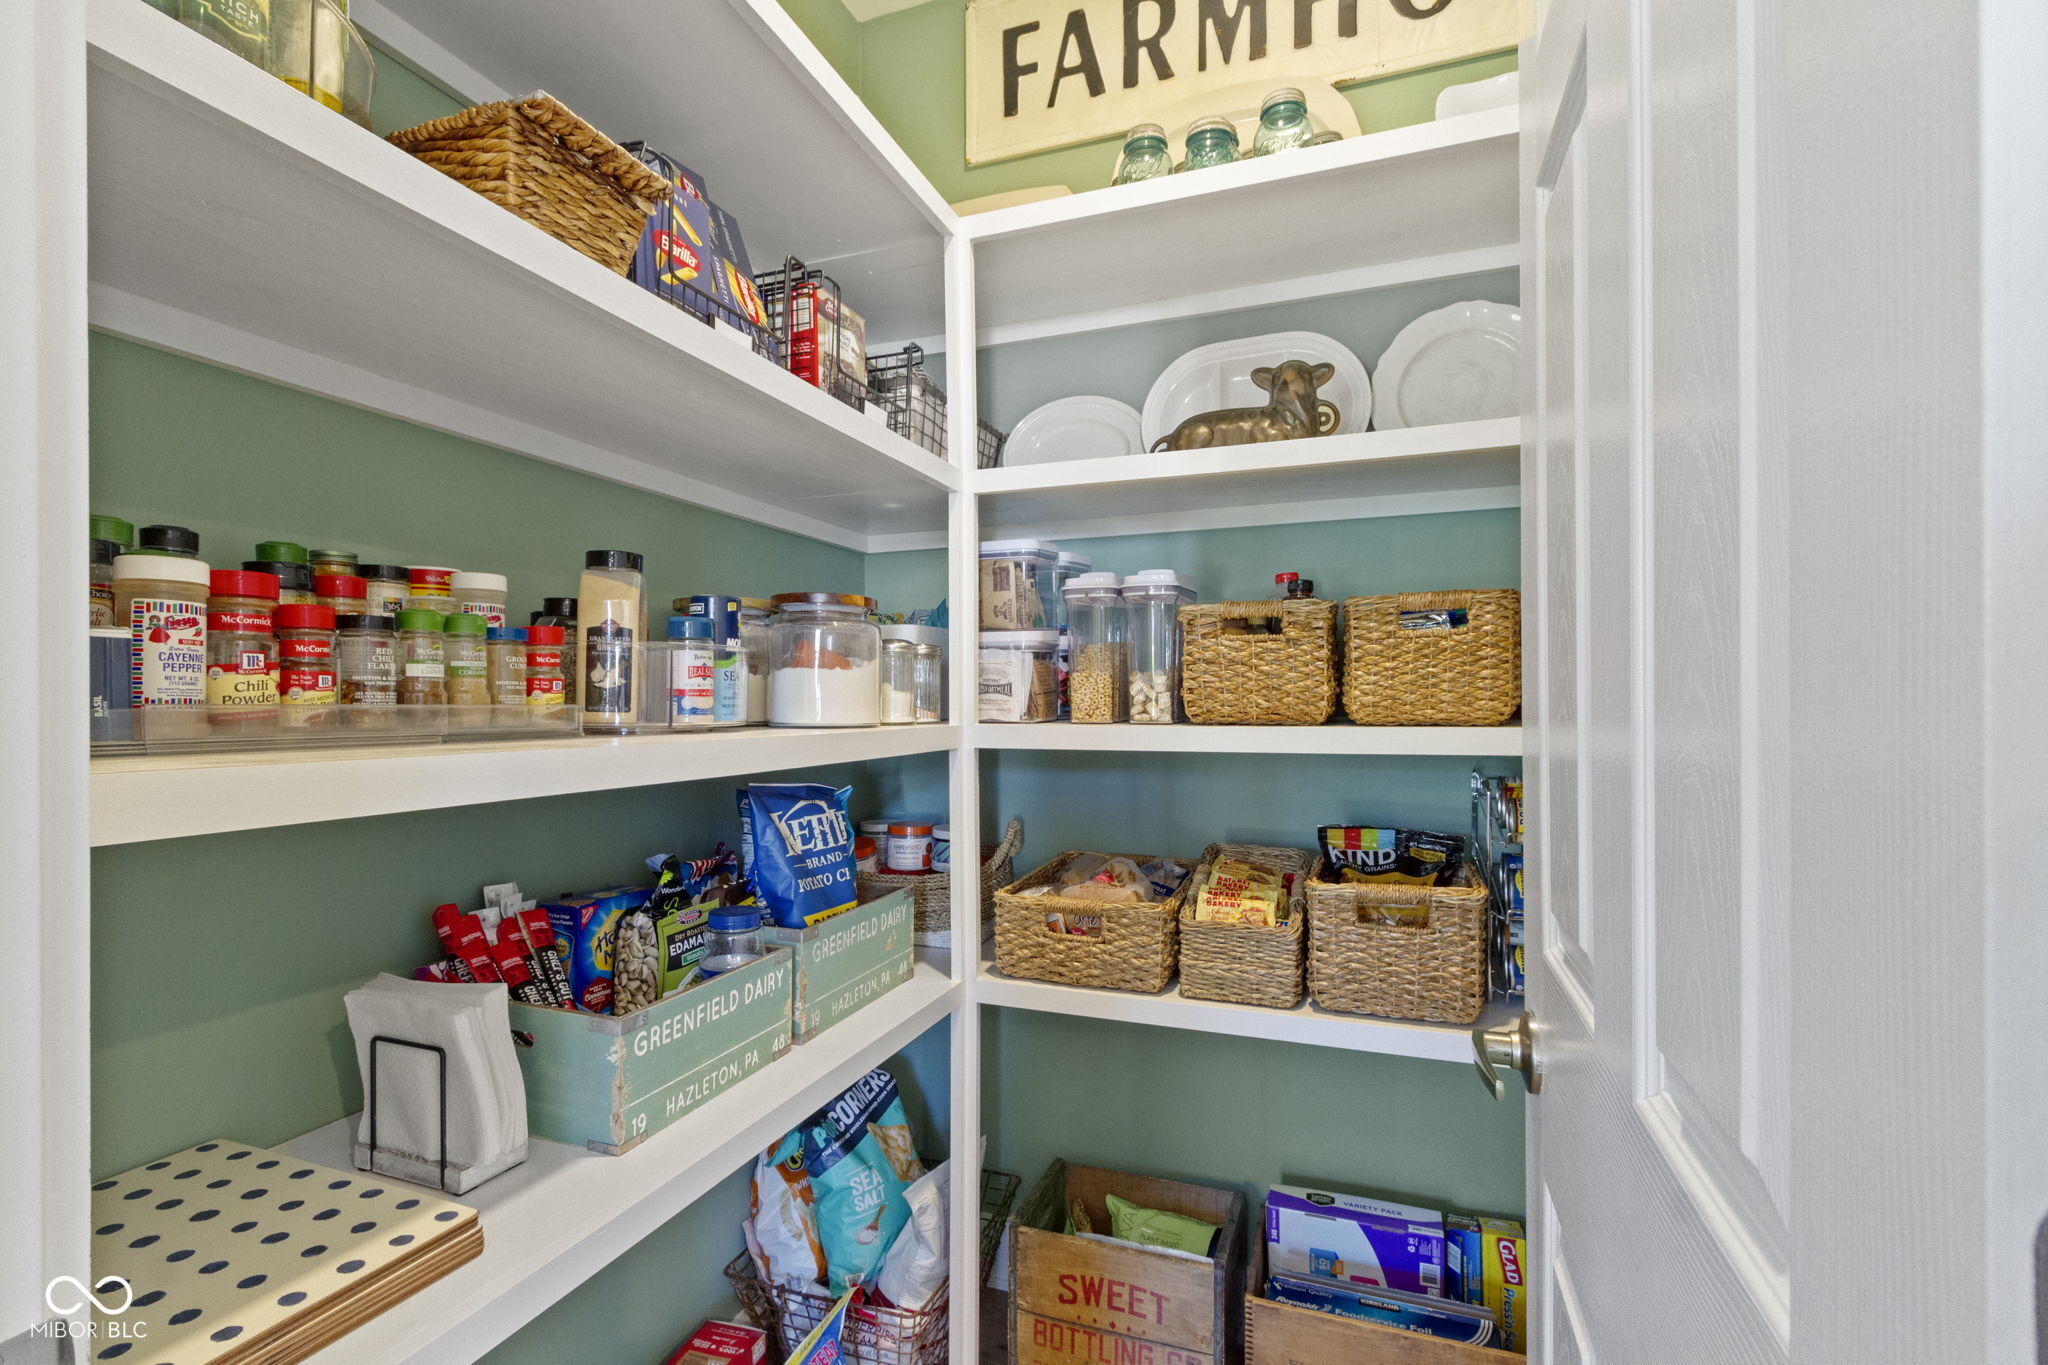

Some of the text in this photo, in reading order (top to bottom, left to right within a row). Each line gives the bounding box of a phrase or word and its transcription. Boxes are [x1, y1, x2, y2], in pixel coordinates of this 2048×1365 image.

[1002, 0, 1448, 118] FARMH
[661, 233, 699, 269] Barilla
[712, 255, 730, 304] SPAGHETTI
[737, 271, 757, 320] Barilla
[385, 602, 401, 612] 365
[221, 615, 272, 627] McCormick
[158, 651, 204, 664] CAYENNE
[375, 647, 393, 655] RED
[162, 662, 202, 674] PEPPER
[234, 679, 269, 693] Chili
[93, 694, 103, 717] BASIL
[222, 691, 277, 705] Powder
[769, 805, 848, 858] KETTLE
[806, 851, 843, 870] BRAND
[1328, 844, 1398, 867] KIND
[1364, 862, 1396, 873] GRAINS
[799, 872, 833, 892] POTATO
[1206, 900, 1242, 909] BAKERY
[674, 923, 708, 942] DRY ROASTE
[812, 916, 878, 963] GREENFIELD
[881, 904, 907, 931] DAIRY
[558, 982, 574, 1000] CUT
[584, 988, 611, 1002] Cinnamon
[810, 1009, 820, 1028] 19
[831, 978, 880, 1017] HAZLETON,
[881, 970, 891, 986] PA
[634, 968, 784, 1057] GREENFIELD DAIRY
[631, 1033, 785, 1137] 19 HAZLETON, PA 48
[822, 1148, 832, 1158] THE
[849, 1168, 884, 1196] SEA
[852, 1184, 885, 1212] SALT
[1343, 1200, 1404, 1216] VARIETY PACK
[1140, 1233, 1180, 1248] PLANT BASED
[1498, 1240, 1520, 1284] GLAD
[1058, 1273, 1170, 1325] SWEET
[1308, 1289, 1334, 1299] Quality
[1360, 1298, 1400, 1311] KIRKLAND
[1275, 1295, 1433, 1336] Reynolds Foodservice Foil
[1033, 1317, 1153, 1365] BOTTLING
